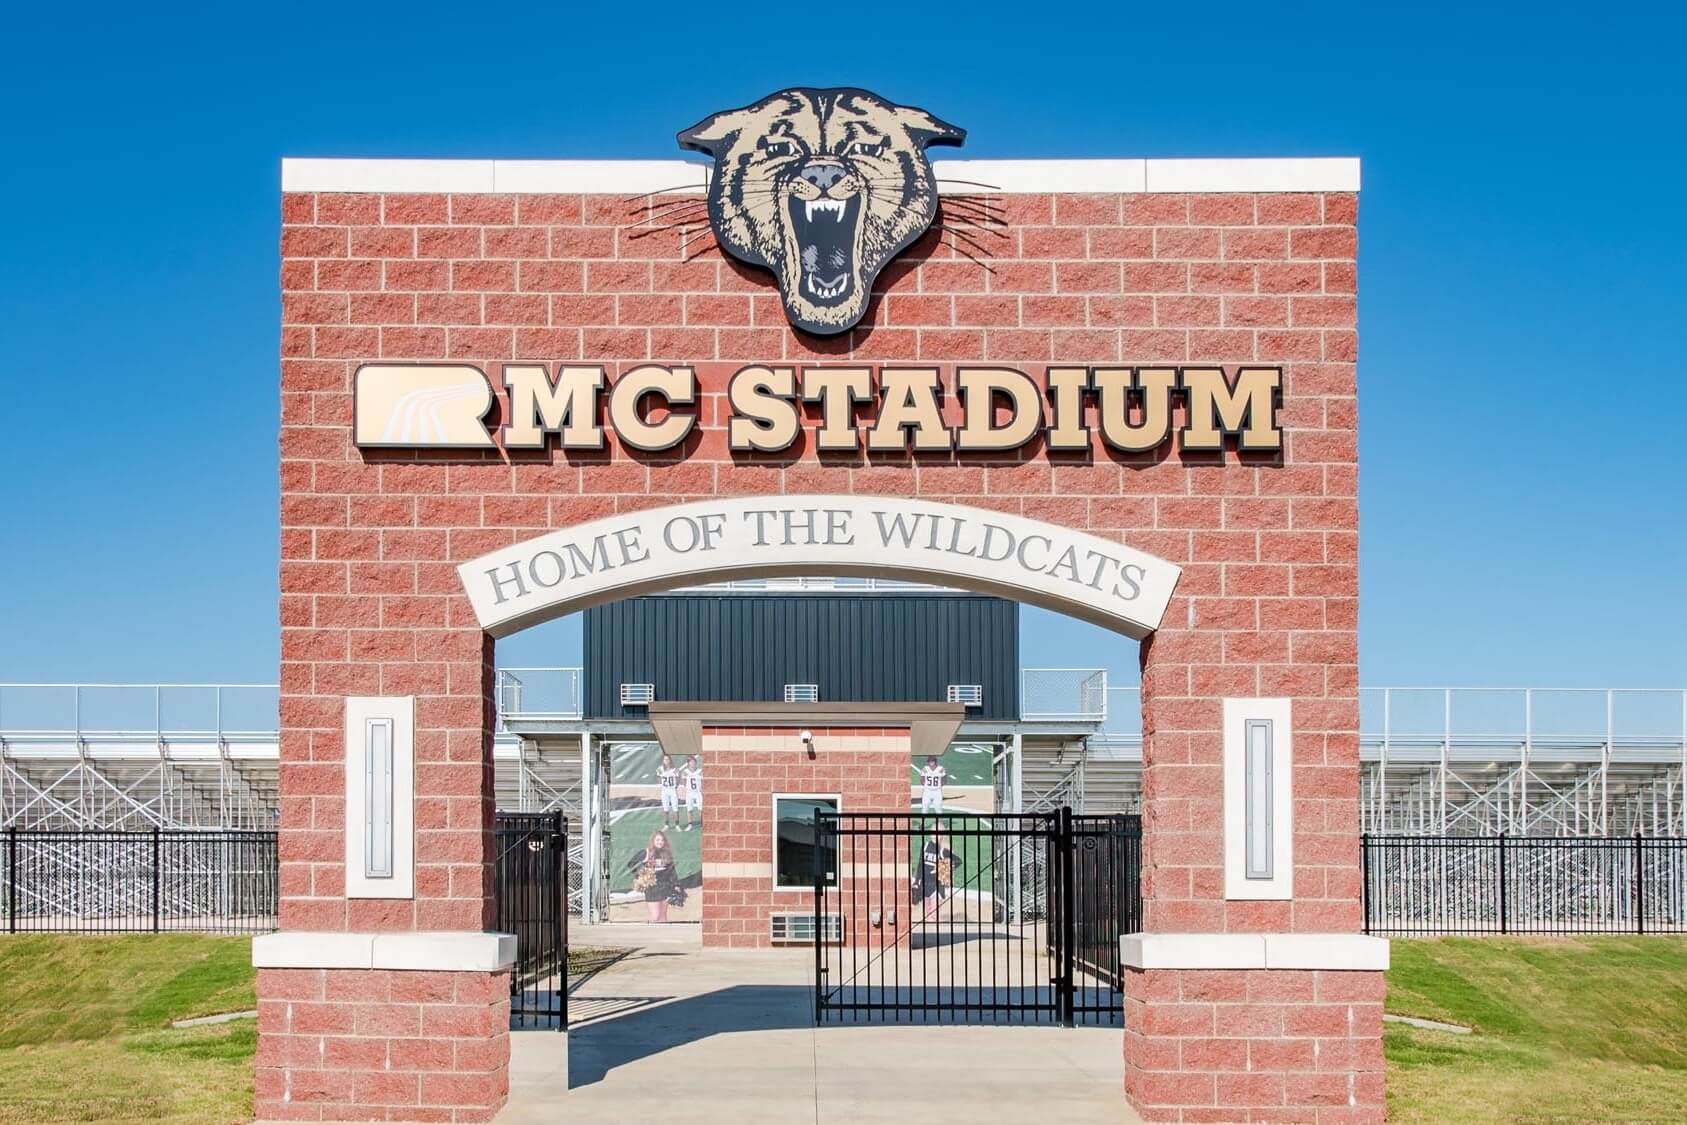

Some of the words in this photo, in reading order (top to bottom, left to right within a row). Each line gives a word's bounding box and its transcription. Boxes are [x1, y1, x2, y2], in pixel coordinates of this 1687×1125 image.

[728, 364, 1283, 452] STADIUM
[484, 525, 651, 606] HOME
[663, 513, 727, 553] OF
[744, 509, 856, 547] THE
[872, 511, 1147, 602] WILDCATS
[662, 776, 675, 787] 20
[690, 777, 698, 790] 6
